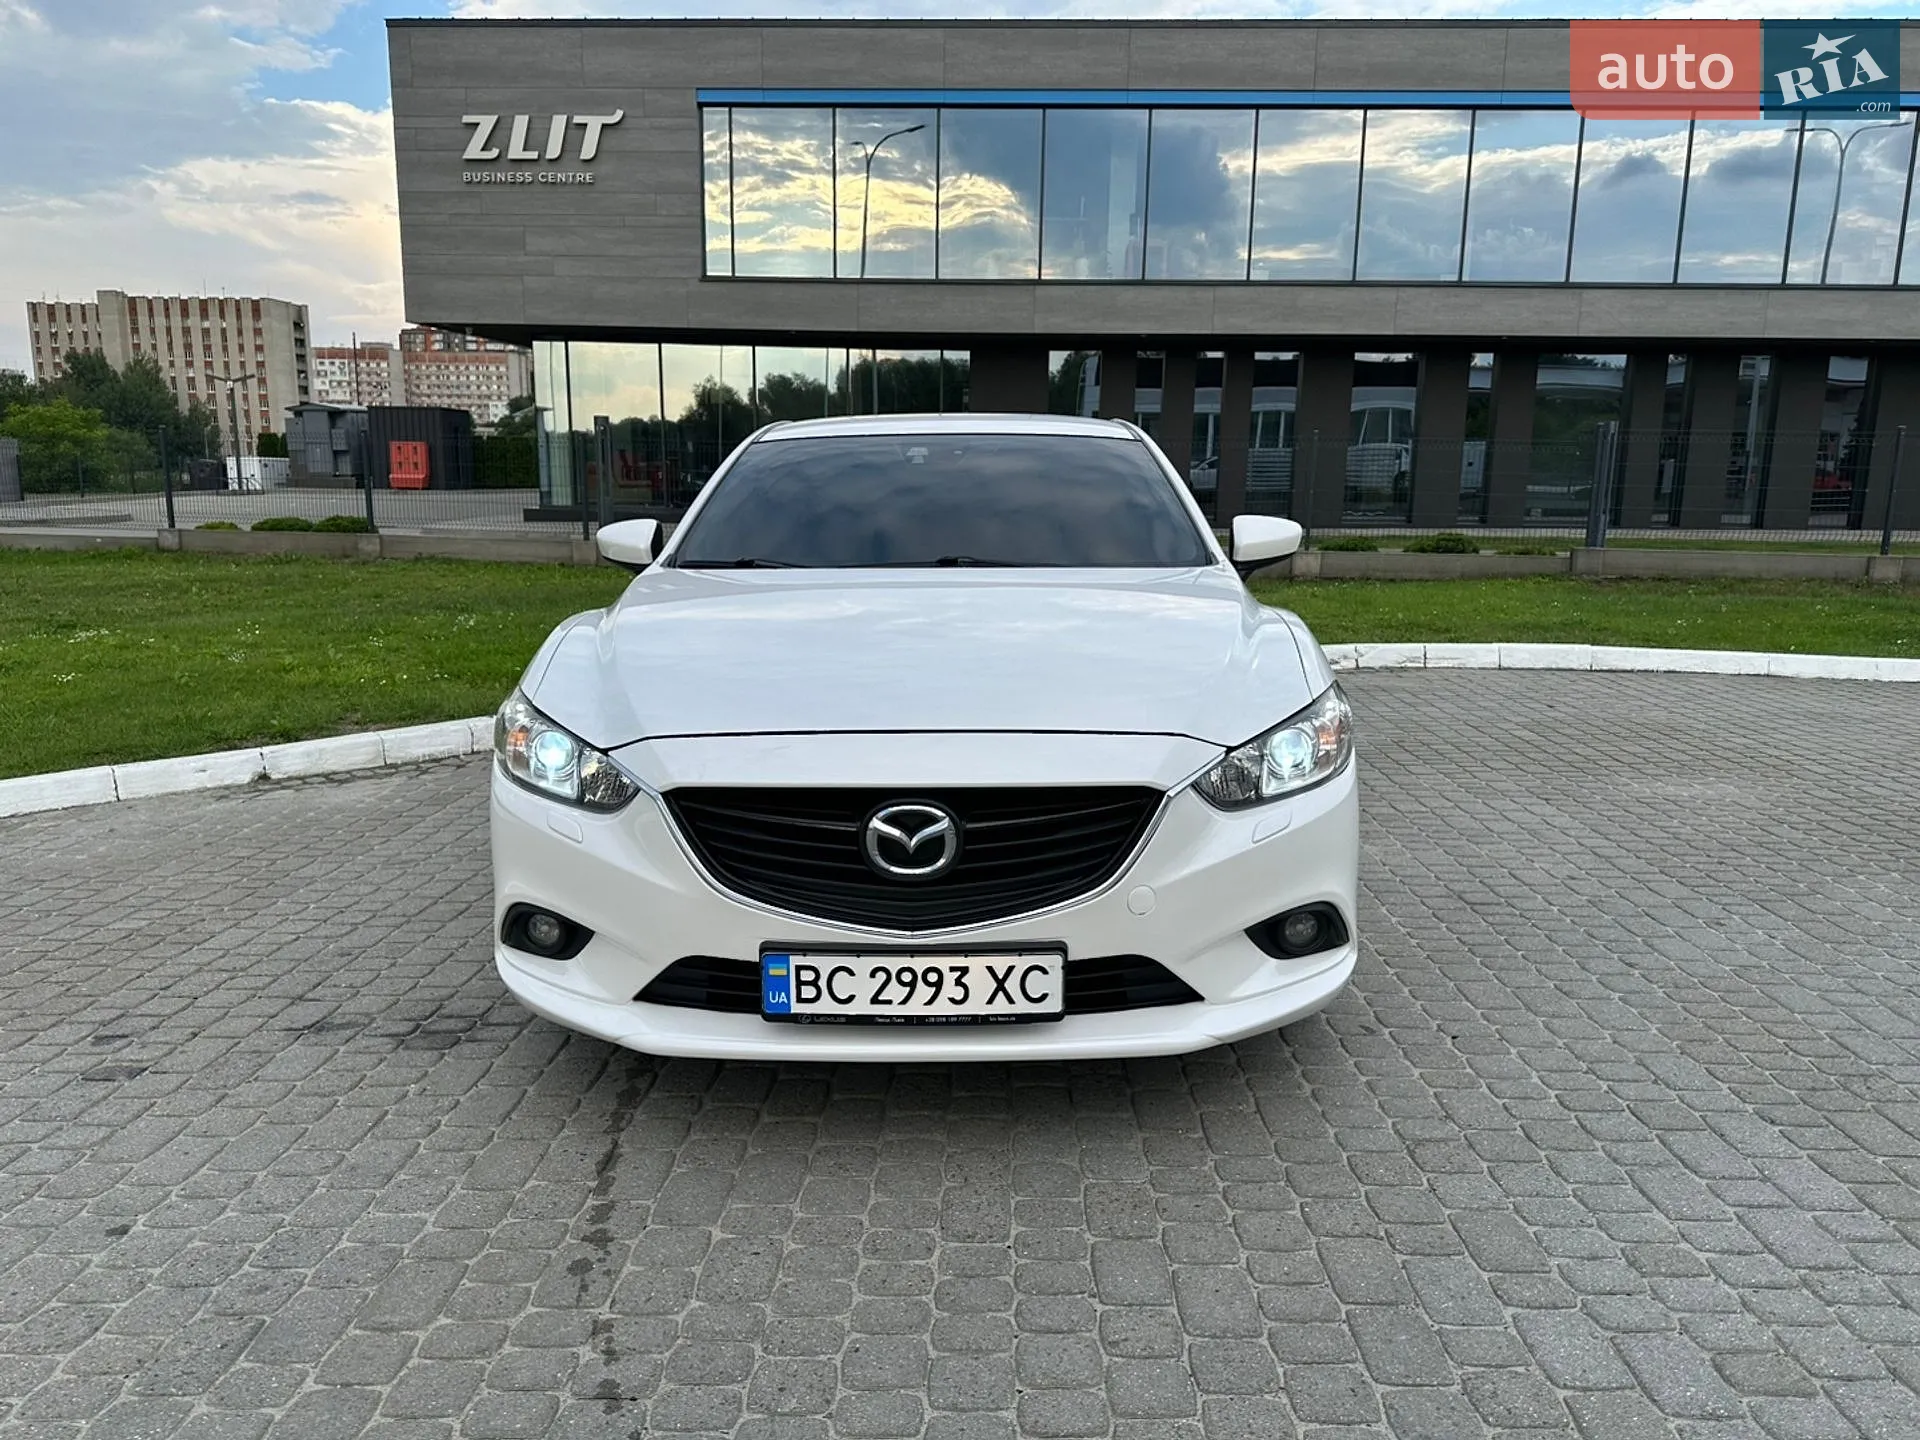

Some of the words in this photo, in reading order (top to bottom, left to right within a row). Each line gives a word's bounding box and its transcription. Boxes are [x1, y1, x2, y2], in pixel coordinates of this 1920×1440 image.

[461, 109, 624, 160] ZLIT
[462, 171, 533, 183] BUSINESS
[538, 171, 594, 183] CENTRE
[769, 991, 788, 1004] UA
[795, 963, 857, 1005] BC
[869, 965, 970, 1006] 2993
[985, 964, 1050, 1006] XC
